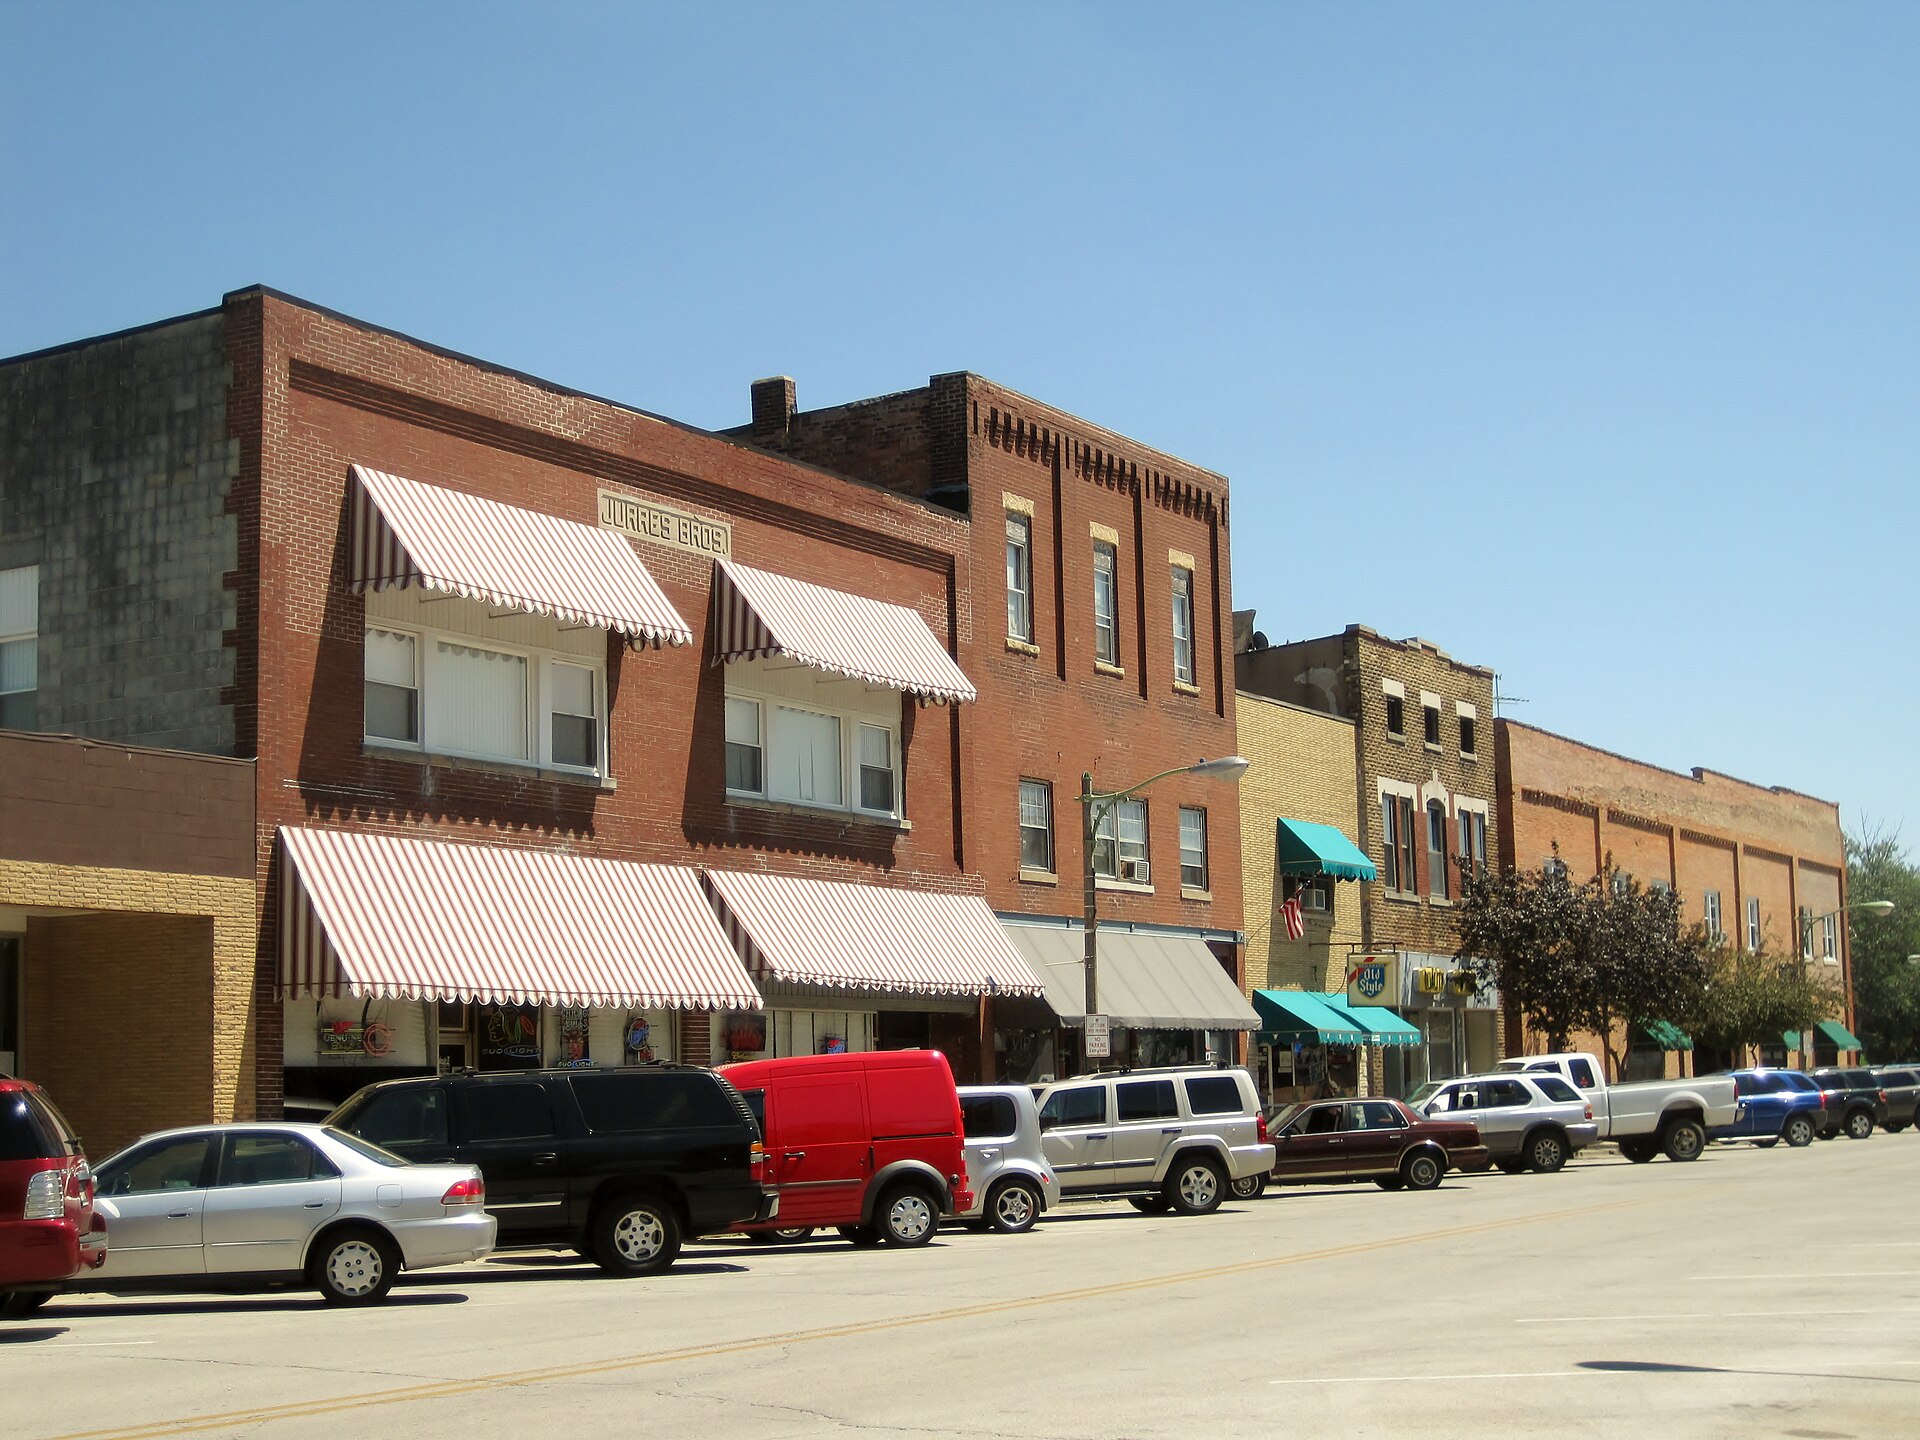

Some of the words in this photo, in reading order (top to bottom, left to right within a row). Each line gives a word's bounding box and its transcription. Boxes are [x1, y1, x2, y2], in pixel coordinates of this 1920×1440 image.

[601, 498, 671, 540] JURRES
[678, 518, 726, 555] BROS.
[1363, 967, 1380, 981] Old
[1359, 978, 1384, 996] Style
